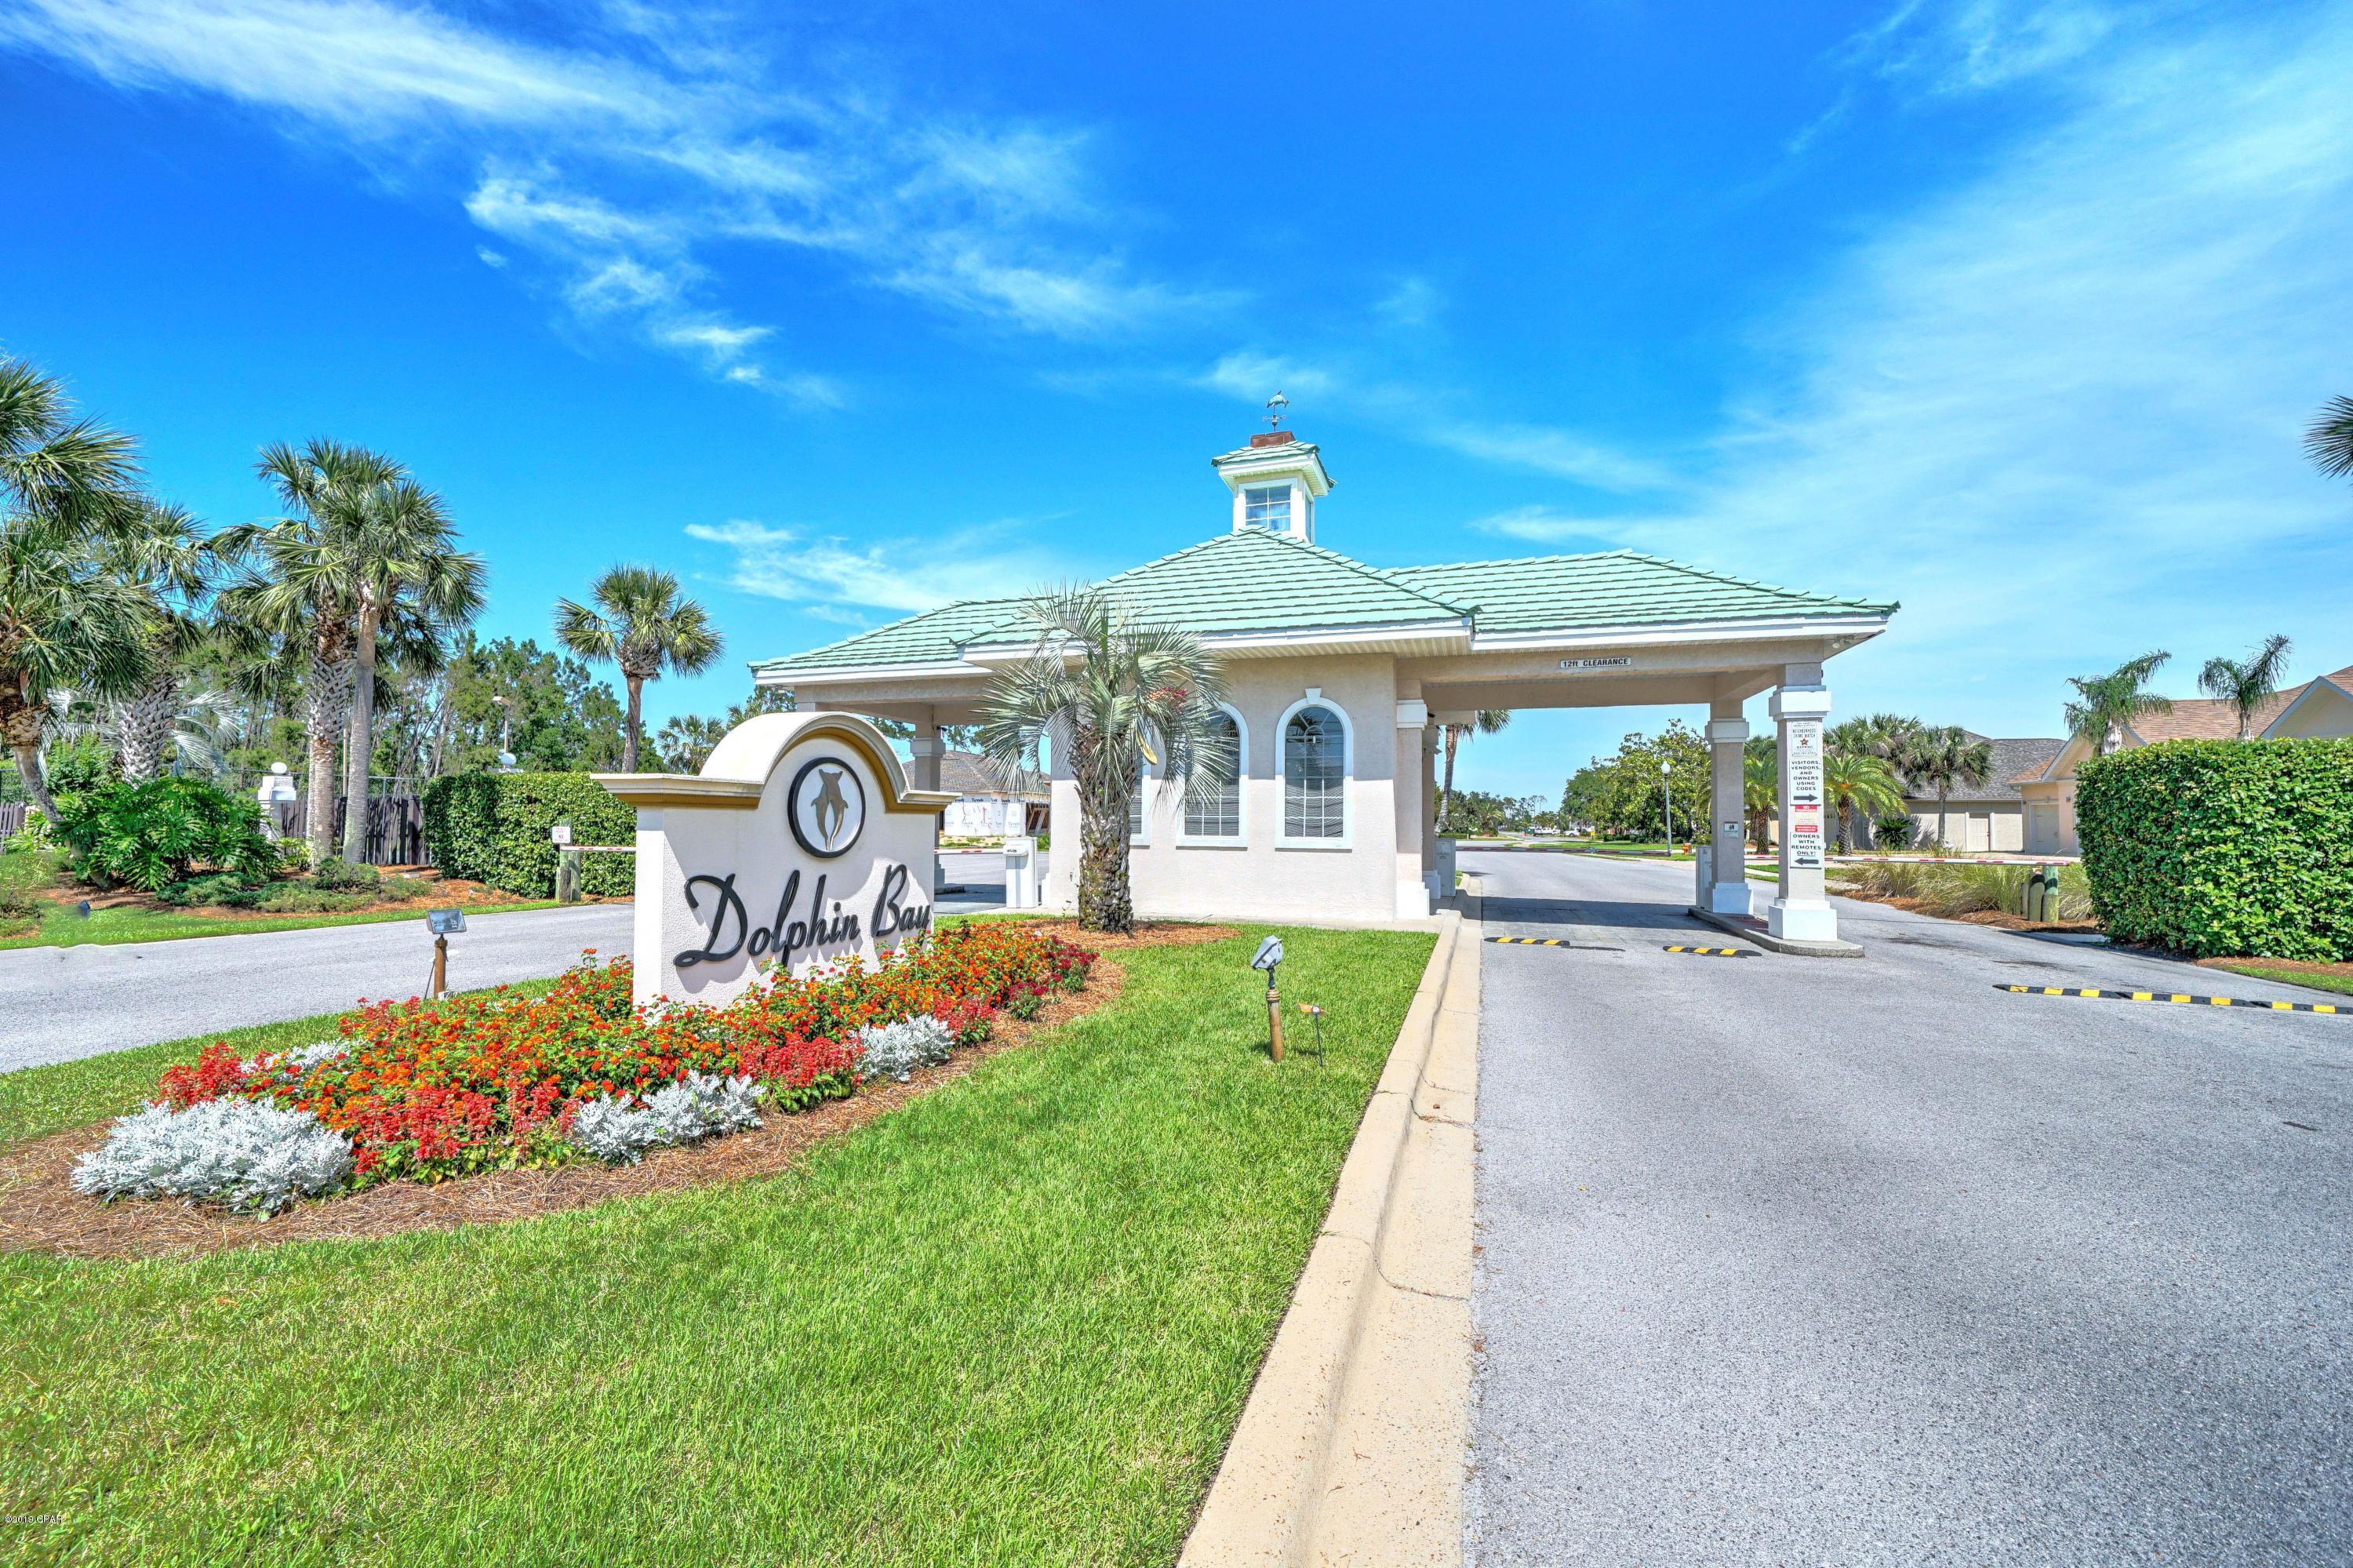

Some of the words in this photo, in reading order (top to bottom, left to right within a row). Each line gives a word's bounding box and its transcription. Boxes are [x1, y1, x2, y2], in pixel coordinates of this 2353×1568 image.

[1583, 658, 1628, 667] CLEARANCE
[673, 870, 861, 968] Dolphin
[871, 864, 931, 947] Bay
